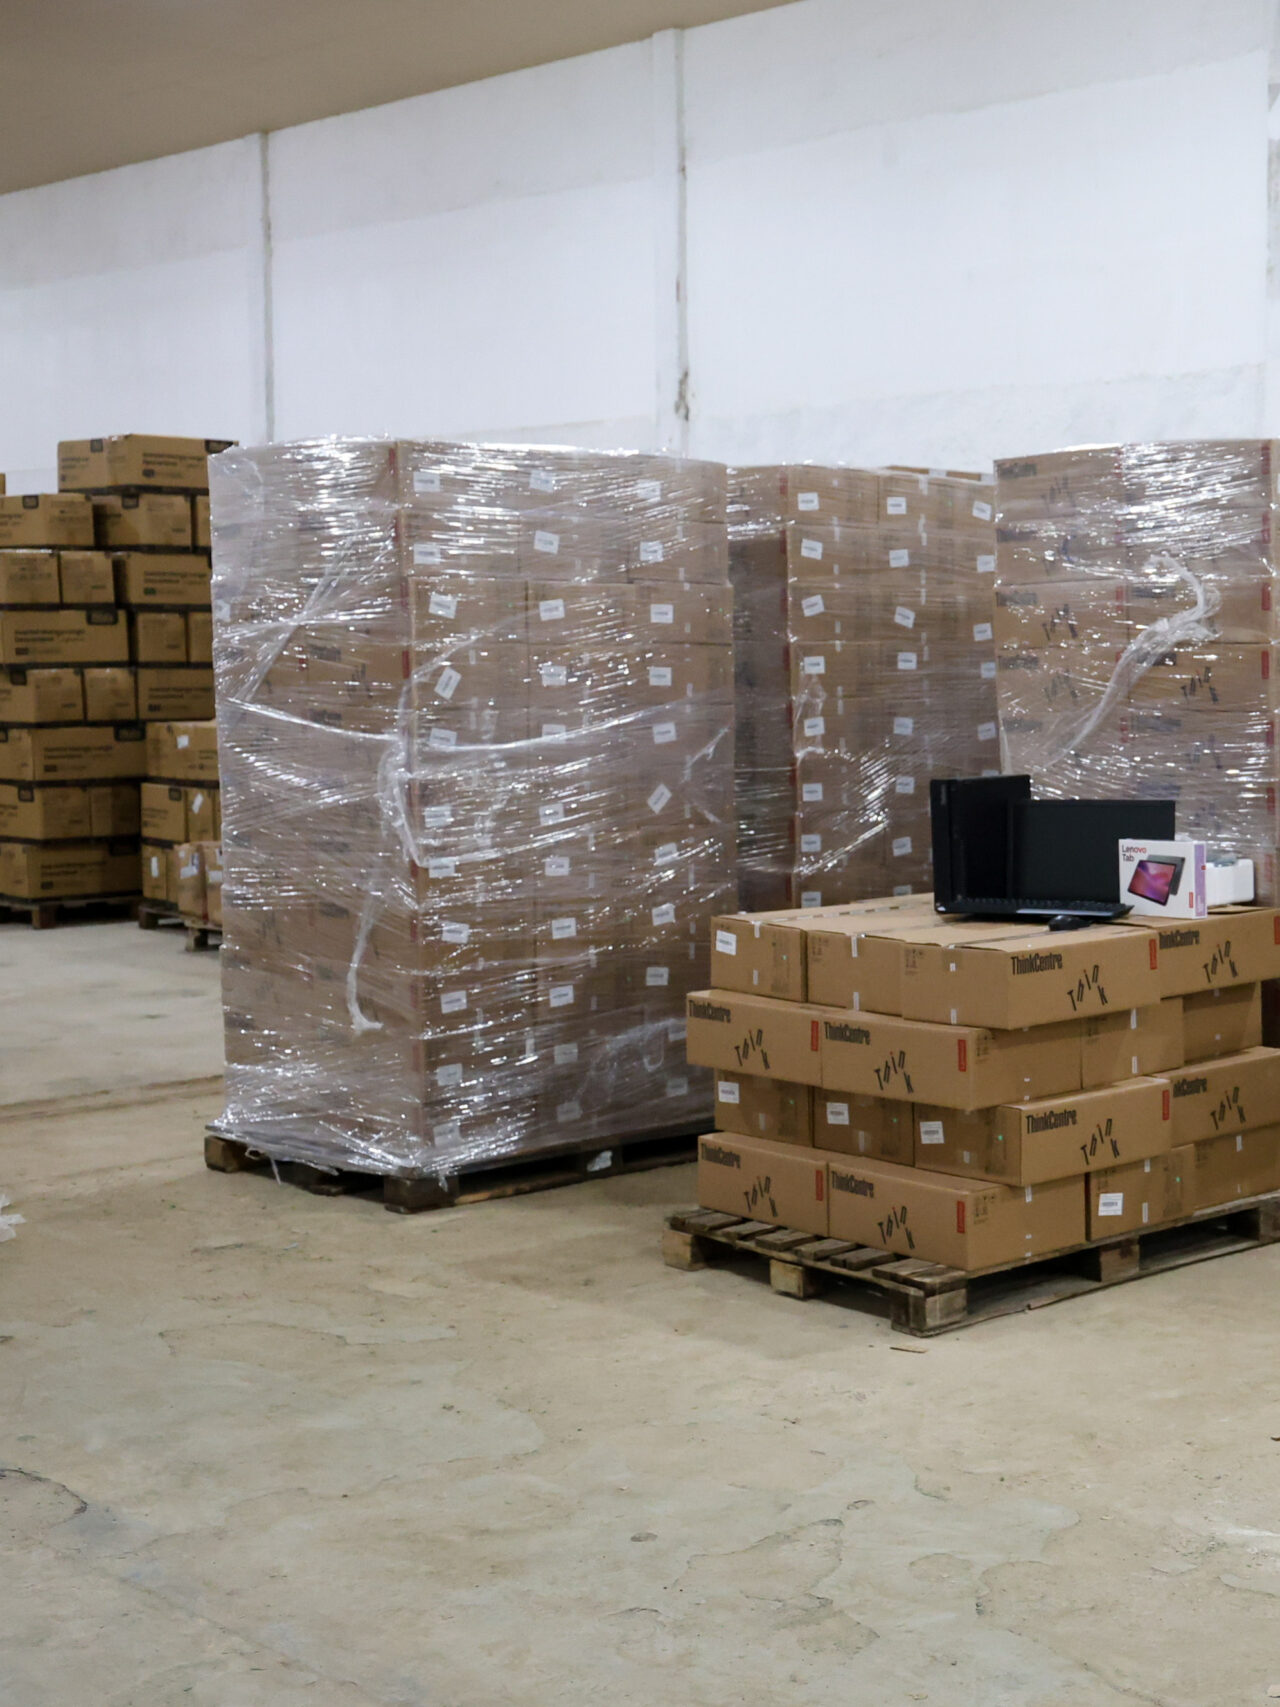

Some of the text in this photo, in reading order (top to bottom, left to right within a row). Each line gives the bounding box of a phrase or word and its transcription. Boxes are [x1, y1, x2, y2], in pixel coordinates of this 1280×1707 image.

[1122, 845, 1147, 853] Lenovo
[1122, 854, 1135, 862] Tab
[1159, 929, 1200, 949] hinkCentre
[1011, 952, 1063, 975] ThinkCentre
[1203, 940, 1239, 984] Think
[1067, 964, 1109, 1012] Think
[689, 1000, 731, 1024] ThinkCentre
[824, 1021, 871, 1046] ThinkCentre
[874, 1050, 914, 1094] Think
[1026, 1109, 1078, 1134] ThinkCentre
[1080, 1118, 1120, 1165] Think
[701, 1143, 741, 1169] ThinkCentre
[832, 1170, 875, 1198] ThinkCentre
